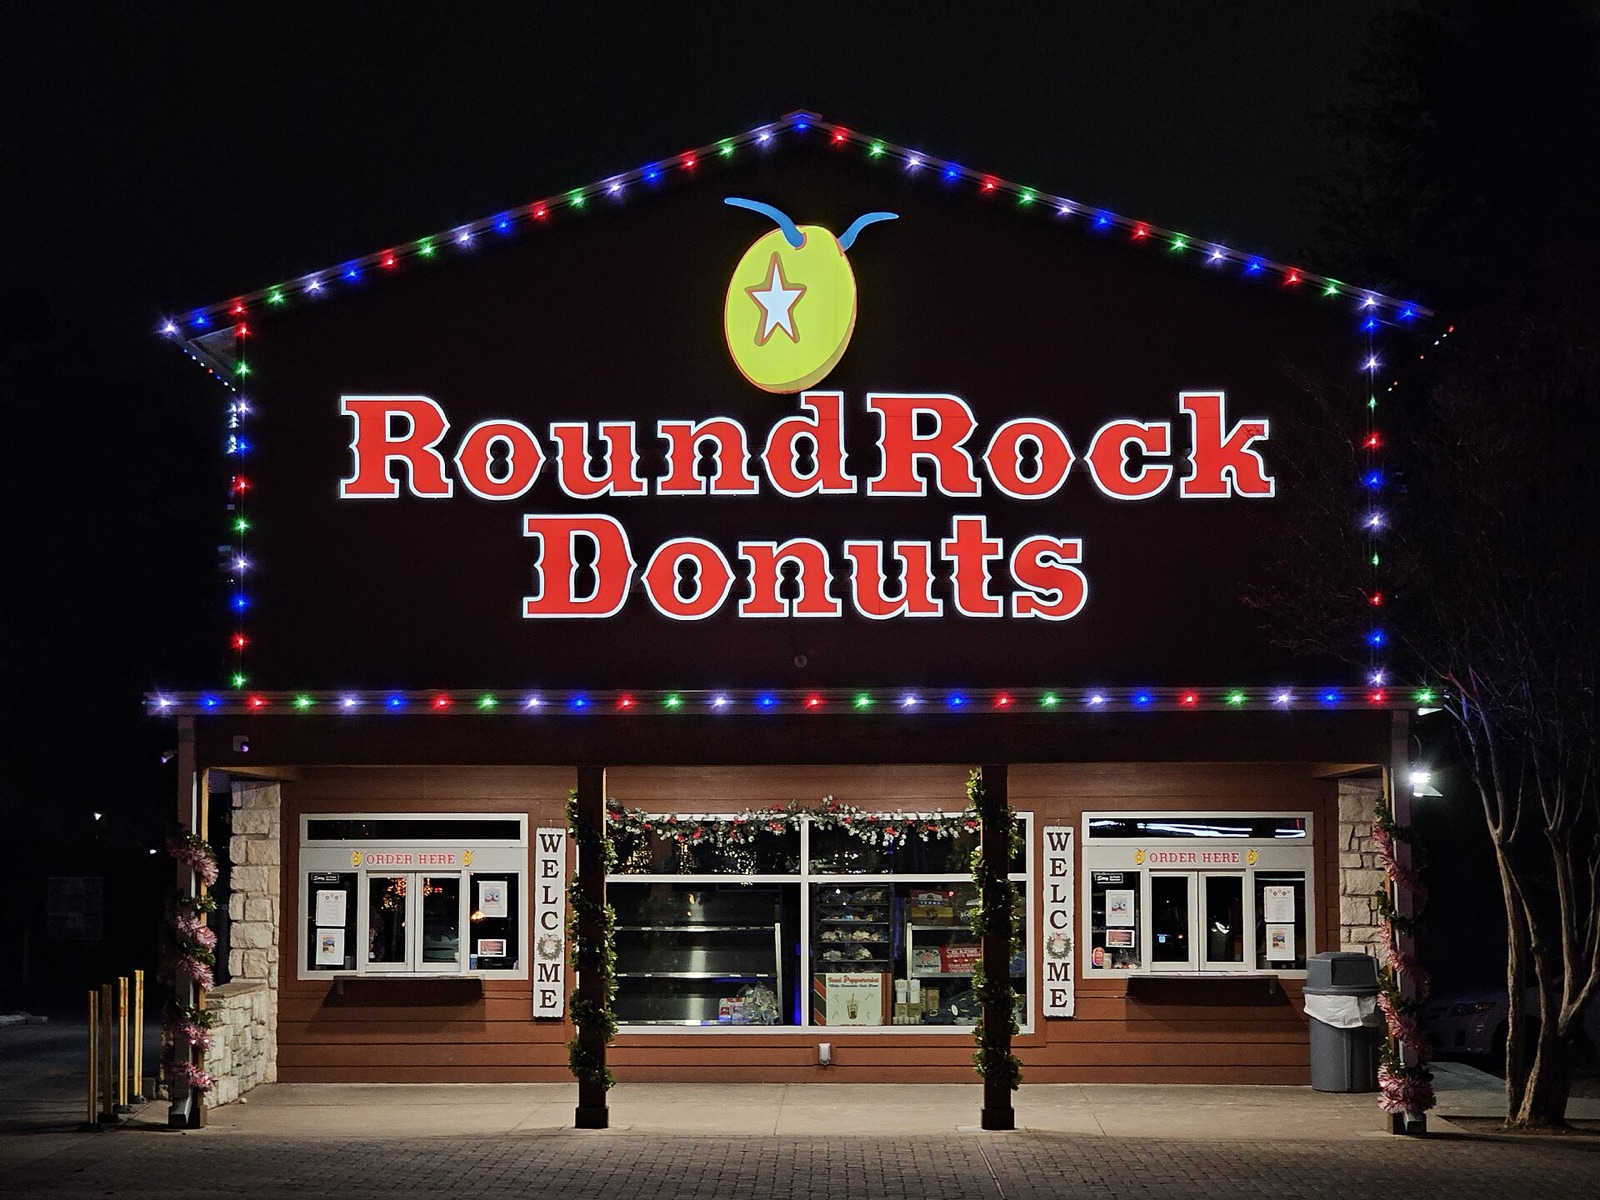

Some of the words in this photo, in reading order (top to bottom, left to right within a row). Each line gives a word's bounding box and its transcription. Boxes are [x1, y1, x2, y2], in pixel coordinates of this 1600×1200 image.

[339, 391, 858, 501] Round
[866, 390, 1276, 501] Rock
[522, 513, 1089, 622] Donuts
[366, 854, 413, 865] ORDER
[418, 854, 455, 865] HERE
[1149, 852, 1197, 863] ORDER
[1201, 852, 1240, 863] HERE
